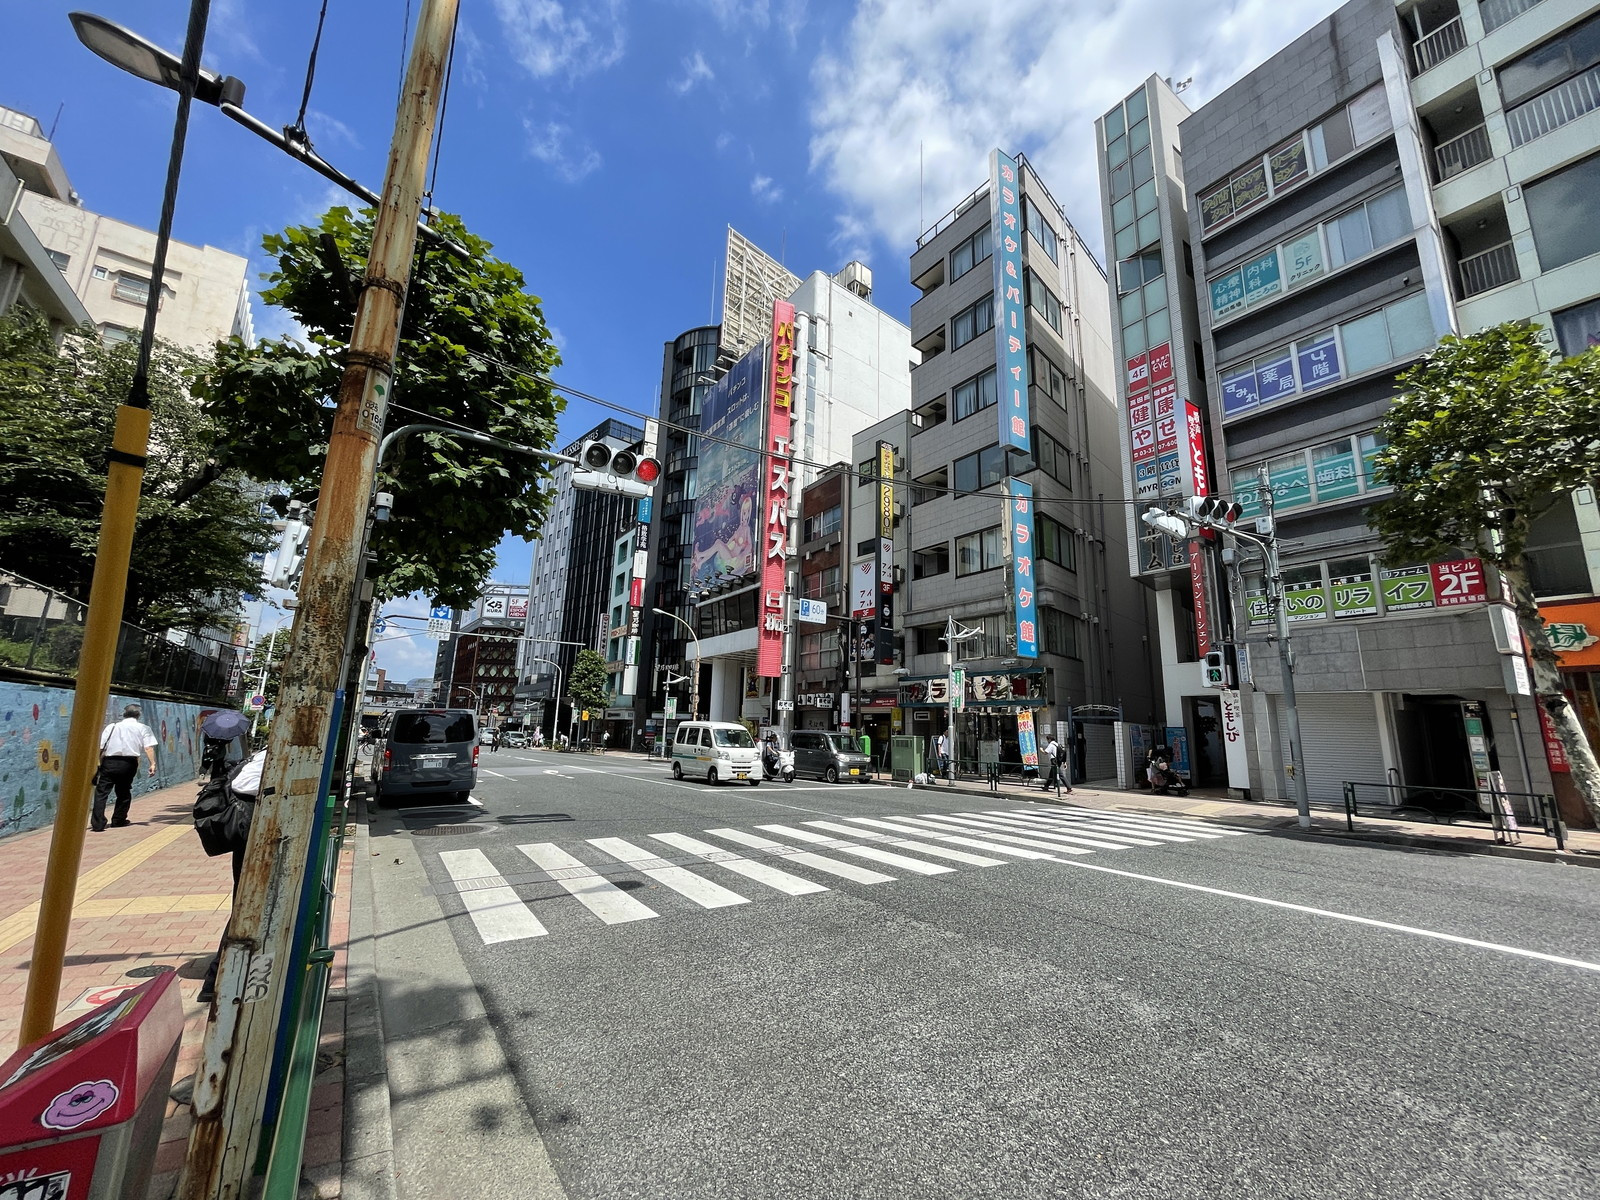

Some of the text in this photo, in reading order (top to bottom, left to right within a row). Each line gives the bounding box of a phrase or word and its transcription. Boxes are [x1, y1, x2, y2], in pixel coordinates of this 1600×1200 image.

[1290, 263, 1321, 282] クリニック
[1295, 255, 1312, 271] 5F
[1000, 162, 1026, 438] カラオケ&パーティー館
[775, 321, 794, 409] パチンコ
[1132, 366, 1146, 379] 4F
[1132, 396, 1175, 425] 健康
[1135, 418, 1176, 446] やせ
[769, 436, 789, 561] エスパス
[1016, 490, 1036, 643] カラオケ館
[1386, 567, 1424, 578] リフォーム
[1438, 561, 1476, 574] 当ビル
[882, 583, 891, 592] 3F
[1439, 571, 1480, 596] 2F
[487, 600, 503, 609] くら
[1248, 581, 1429, 617] 住いの リライフ
[1224, 700, 1240, 743] ともしび
